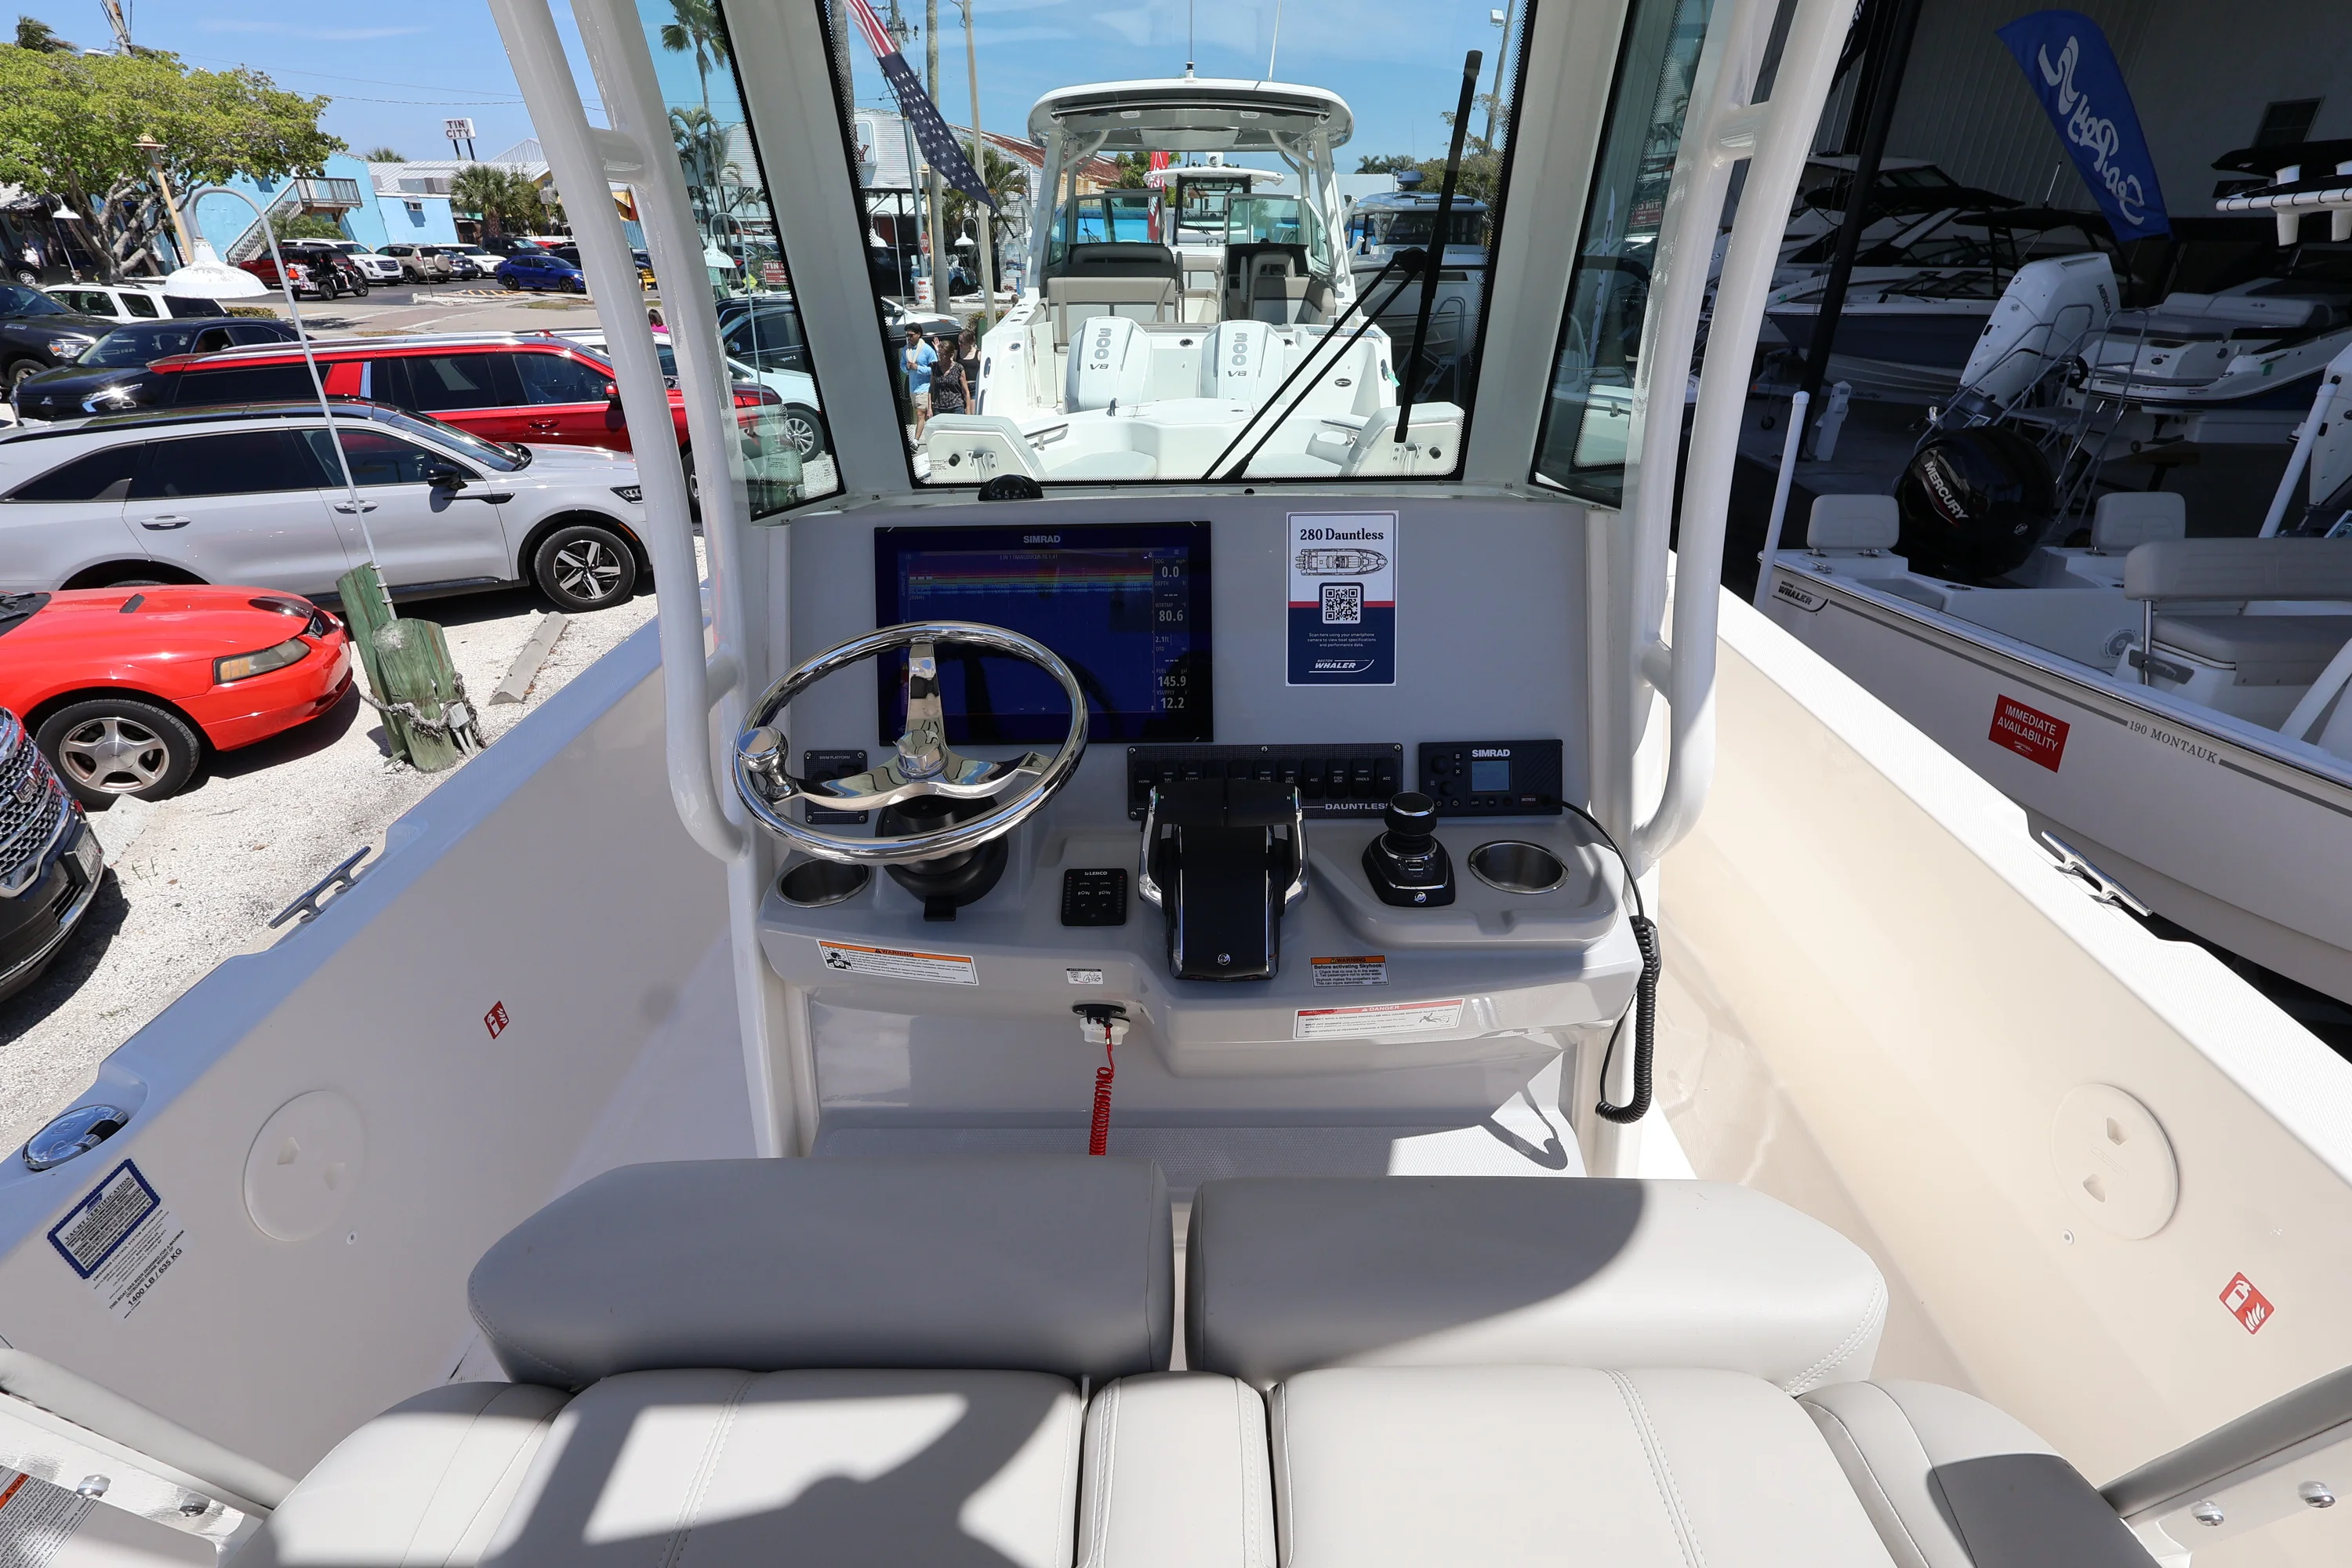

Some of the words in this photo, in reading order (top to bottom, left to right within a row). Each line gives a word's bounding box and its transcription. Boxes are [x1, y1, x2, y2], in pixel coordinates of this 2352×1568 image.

[446, 120, 465, 129] TIN
[446, 129, 469, 137] CITY
[2096, 284, 2112, 318] MERCUR
[1094, 328, 1112, 360] 300
[1232, 332, 1248, 366] 300
[1924, 460, 1969, 519] MERCURY
[1300, 528, 1323, 540] 280
[1326, 528, 1384, 540] Dauntless
[1161, 566, 1179, 578] 0.0
[1778, 585, 1812, 605] WHALER
[1159, 610, 1183, 622] 80.6
[1158, 676, 1186, 687] 145.9
[1160, 697, 1185, 709] 12.2
[2005, 704, 2057, 735] IMMEDIATE
[1997, 717, 2059, 751] AVAILABILITY
[2129, 720, 2147, 735] 190
[2151, 728, 2218, 764] MONTAUK
[1472, 749, 1511, 757] SIMRAD
[64, 1219, 85, 1241] YACHT
[85, 1175, 131, 1221] CERTIFICATION
[85, 1251, 102, 1269] BOSTON
[100, 1236, 118, 1252] WHALER
[93, 1261, 112, 1282] EMISSIONS
[111, 1244, 129, 1262] CONTROL
[127, 1230, 142, 1245] SYSTEM
[140, 1208, 163, 1232] INFORMATION
[108, 1300, 118, 1309] THIS
[117, 1290, 127, 1301] BOAT
[126, 1282, 135, 1290] HAS
[133, 1272, 143, 1283] BEEN
[143, 1255, 160, 1273] DESIGNED
[158, 1247, 167, 1256] FOR
[169, 1229, 185, 1246] MAXIMUM
[125, 1277, 145, 1298] OUTBOARD
[143, 1264, 158, 1278] ENGINE
[156, 1250, 170, 1265] WEIGHT
[126, 1287, 145, 1306] 1400
[143, 1276, 155, 1288] LB
[157, 1259, 171, 1273] 635
[169, 1247, 183, 1260] KG
[2, 1530, 17, 1548] COAST
[16, 1512, 33, 1530] GUARD
[31, 1485, 55, 1512] APPROVED
[7, 1497, 24, 1516] SEATED
[23, 1486, 34, 1497] AND
[1, 1530, 24, 1557] OVERLOAD
[24, 1519, 33, 1530] THE
[9, 1541, 20, 1552] AND
[19, 1522, 35, 1541] EVENLY
[34, 1491, 61, 1523] DISTRIBUTED
[17, 1551, 27, 1562] AND
[26, 1537, 39, 1551] OBEY
[38, 1526, 48, 1537] THE
[47, 1497, 73, 1526] DESIGNATED
[24, 1541, 47, 1567] OPERATOR
[44, 1542, 53, 1552] THE
